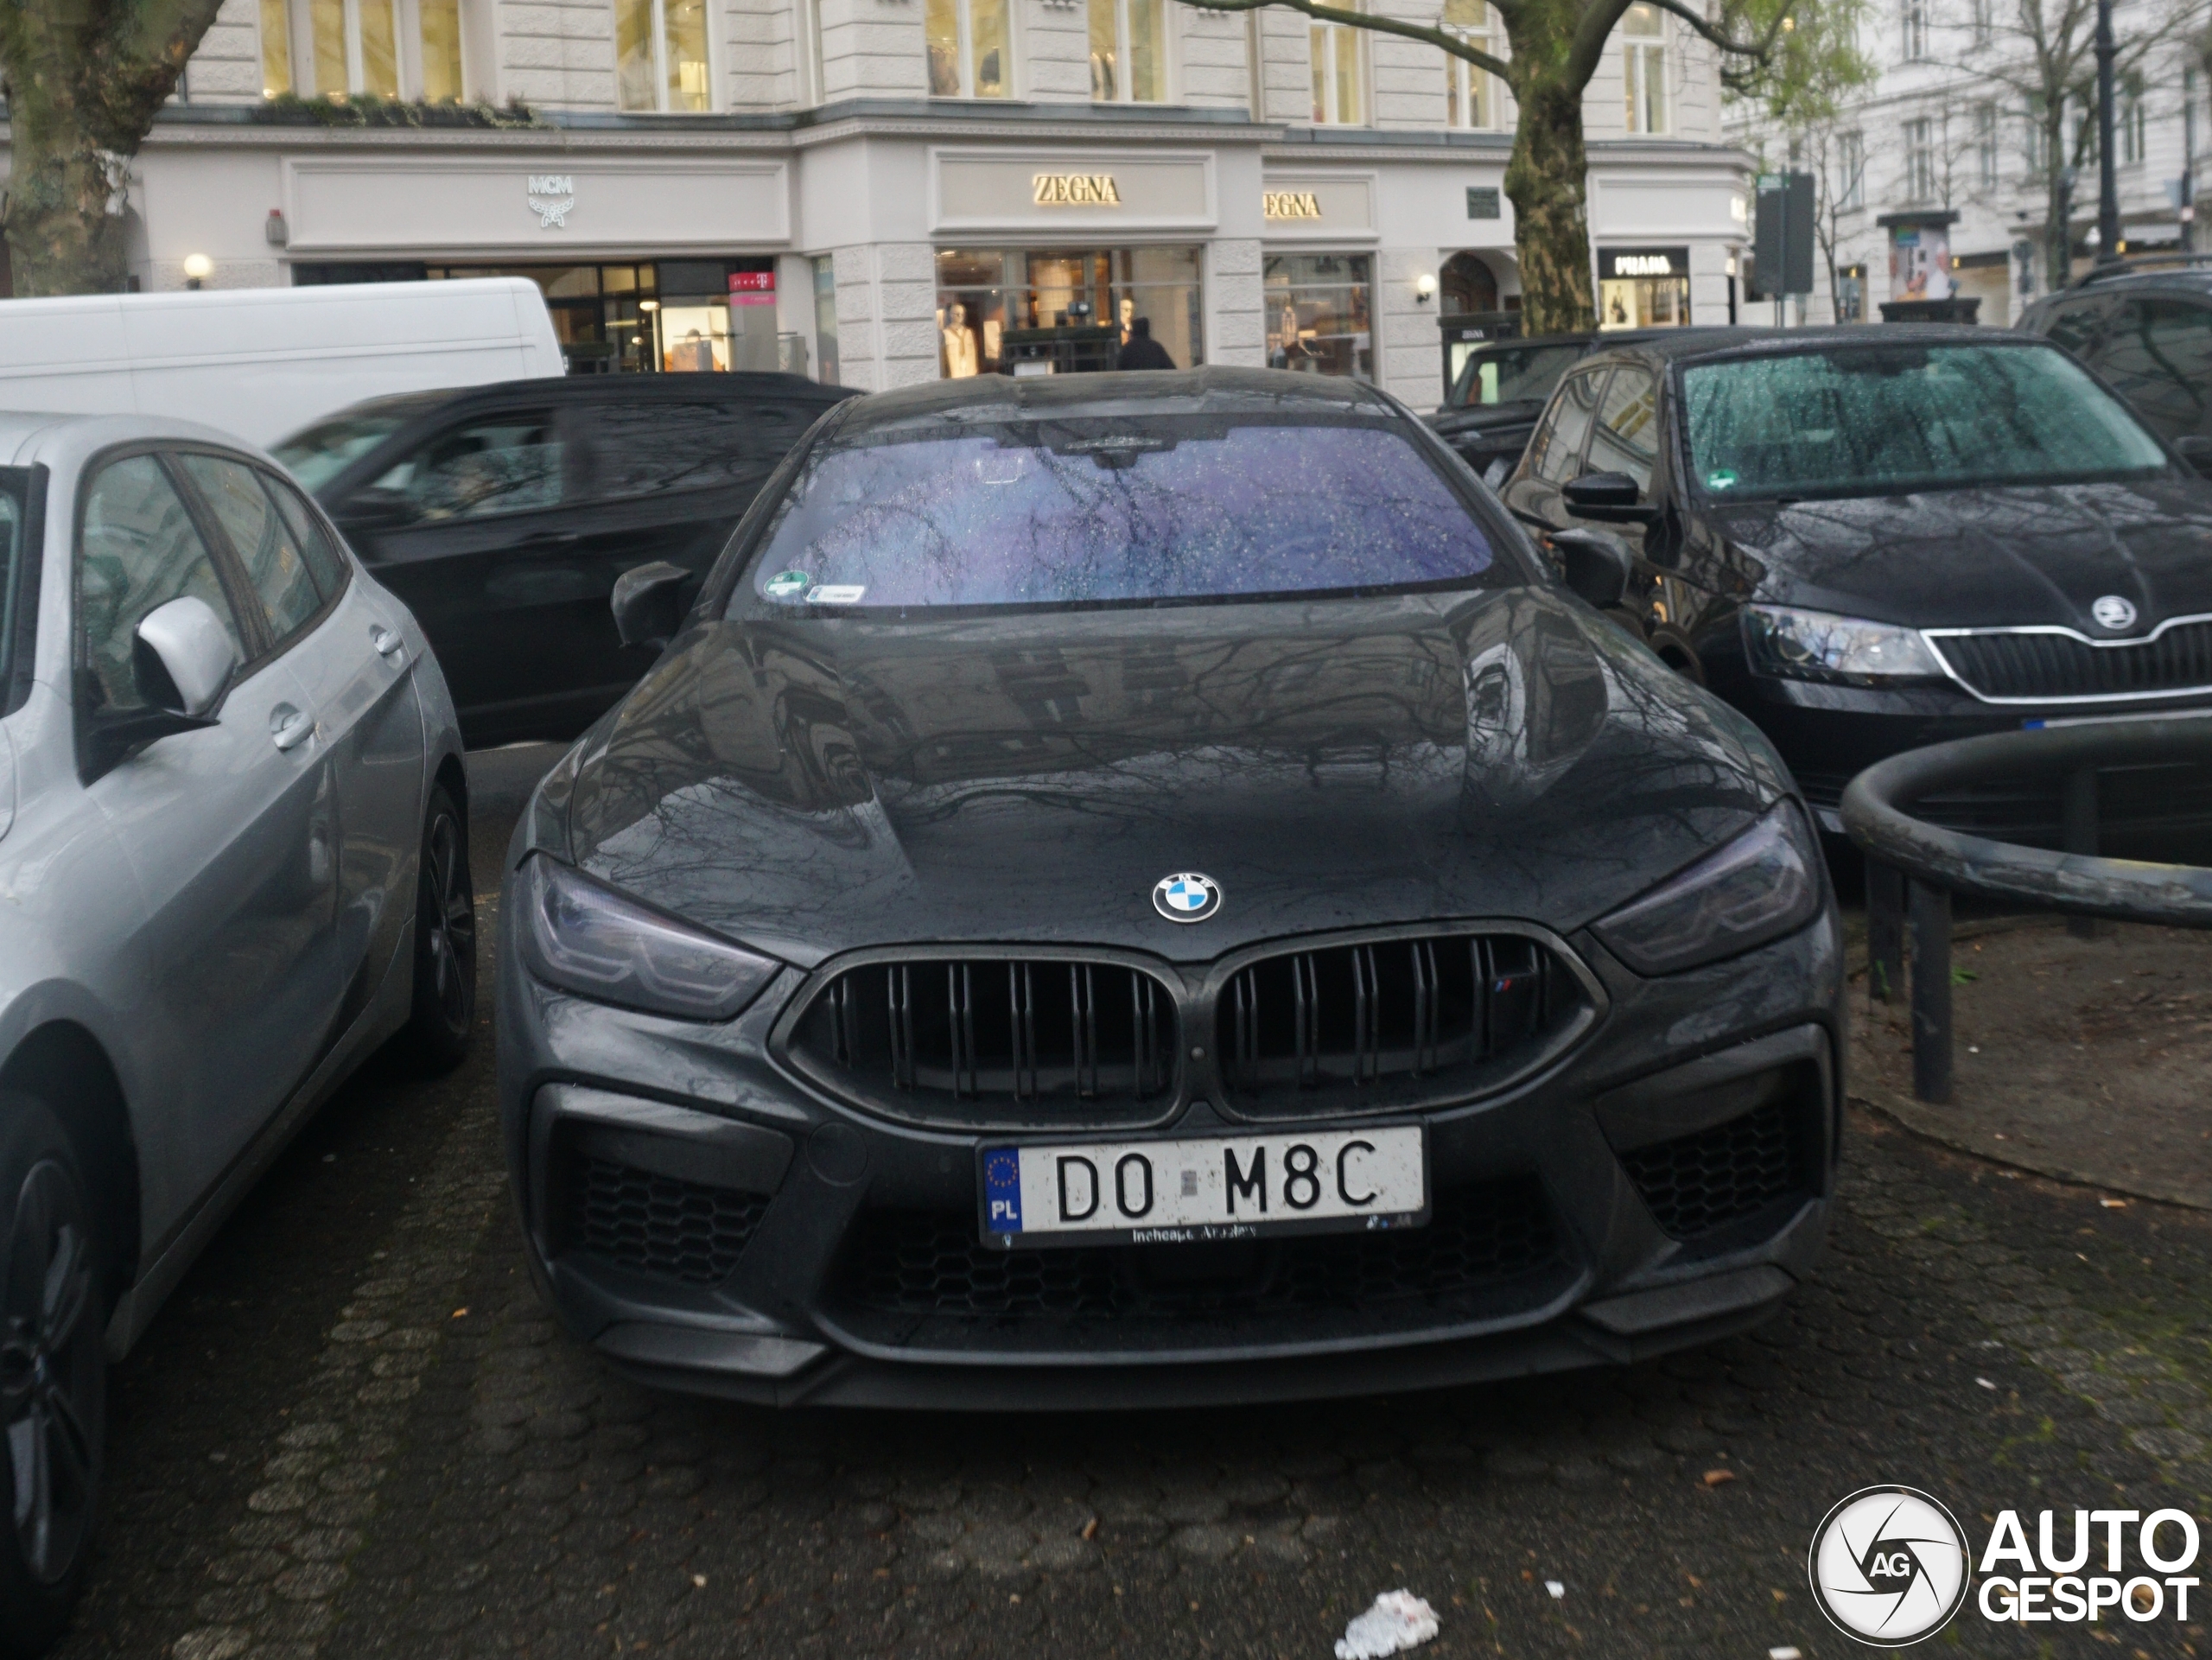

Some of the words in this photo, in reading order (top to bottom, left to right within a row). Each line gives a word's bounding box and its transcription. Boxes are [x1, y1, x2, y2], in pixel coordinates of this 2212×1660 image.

[528, 175, 573, 194] MCM
[1036, 175, 1122, 202] ZEGNA
[1263, 193, 1323, 217] EGNA
[1224, 1140, 1378, 1215] M8C
[991, 1199, 1018, 1220] PL
